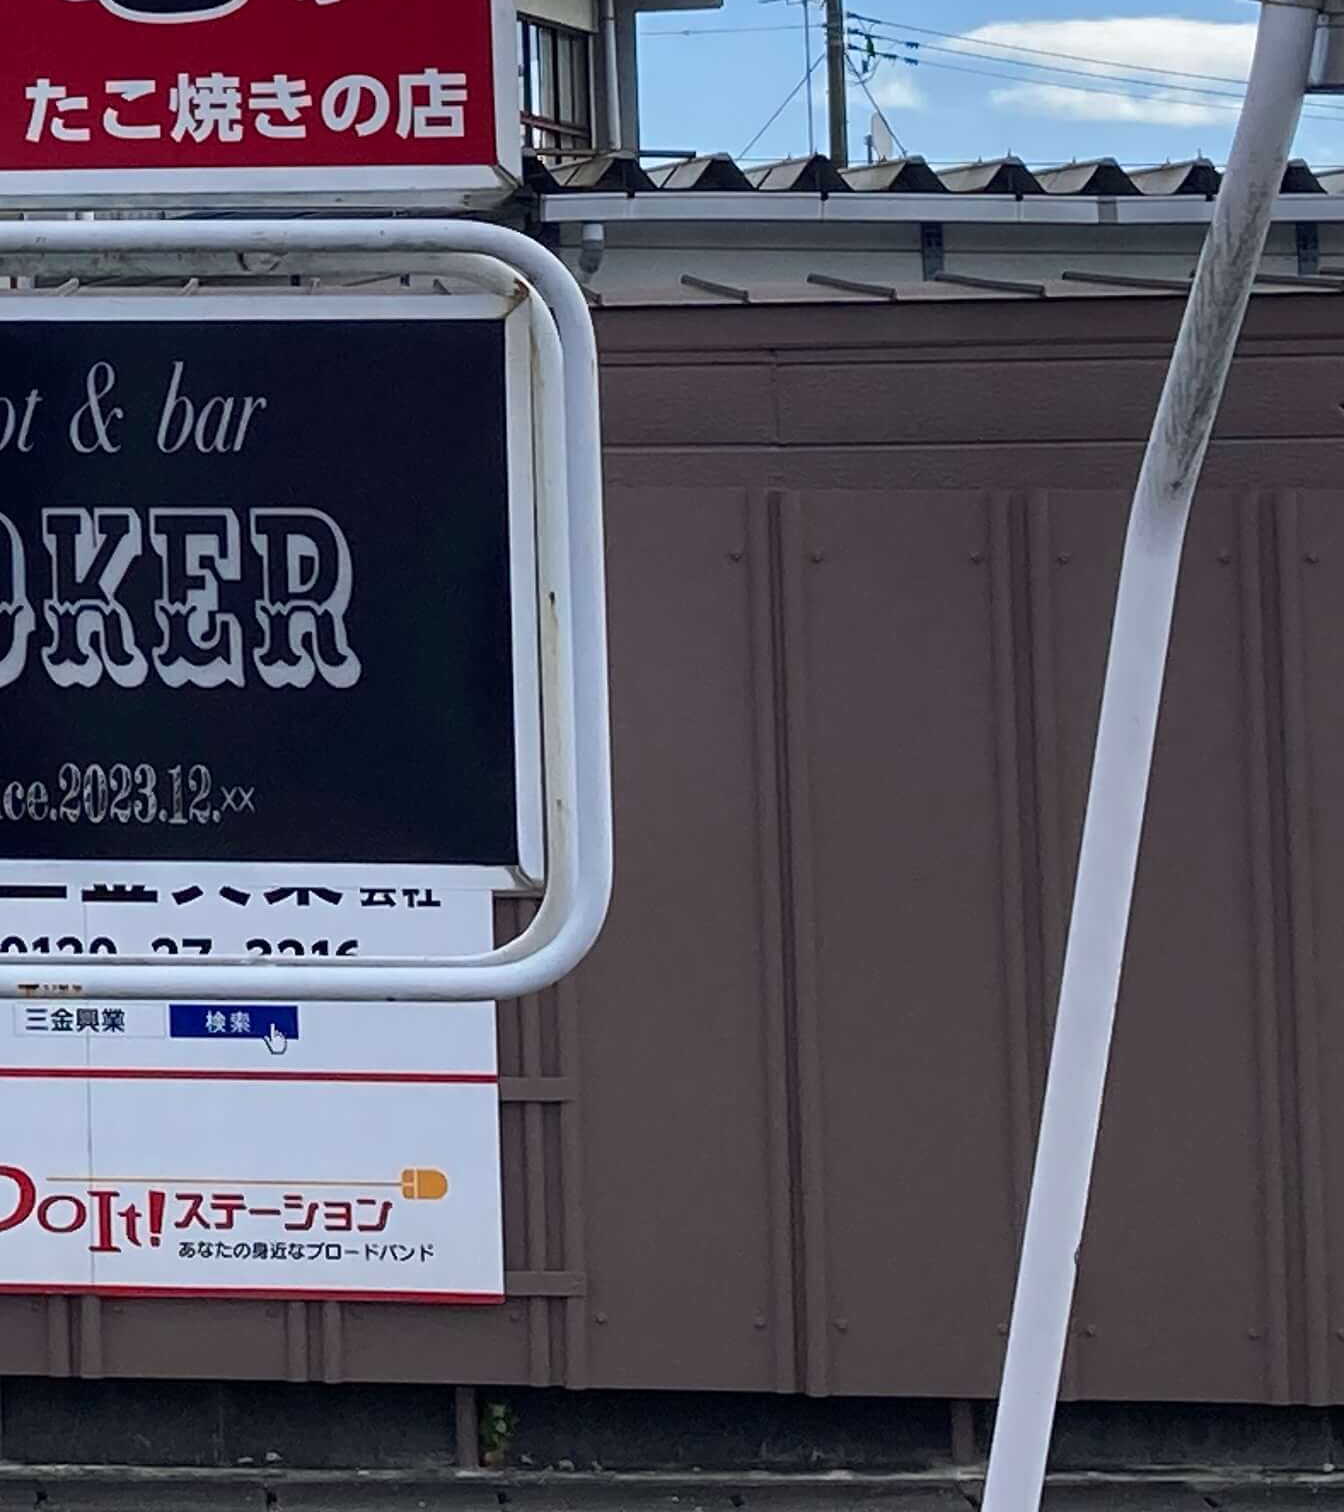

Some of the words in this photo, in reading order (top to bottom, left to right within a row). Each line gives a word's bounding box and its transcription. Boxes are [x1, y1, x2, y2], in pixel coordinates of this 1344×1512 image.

[26, 68, 469, 144] たこ焼きの店
[69, 361, 124, 455] &
[157, 361, 268, 454] bar
[25, 1007, 125, 1032] 三金興業
[205, 1009, 251, 1034] 検索
